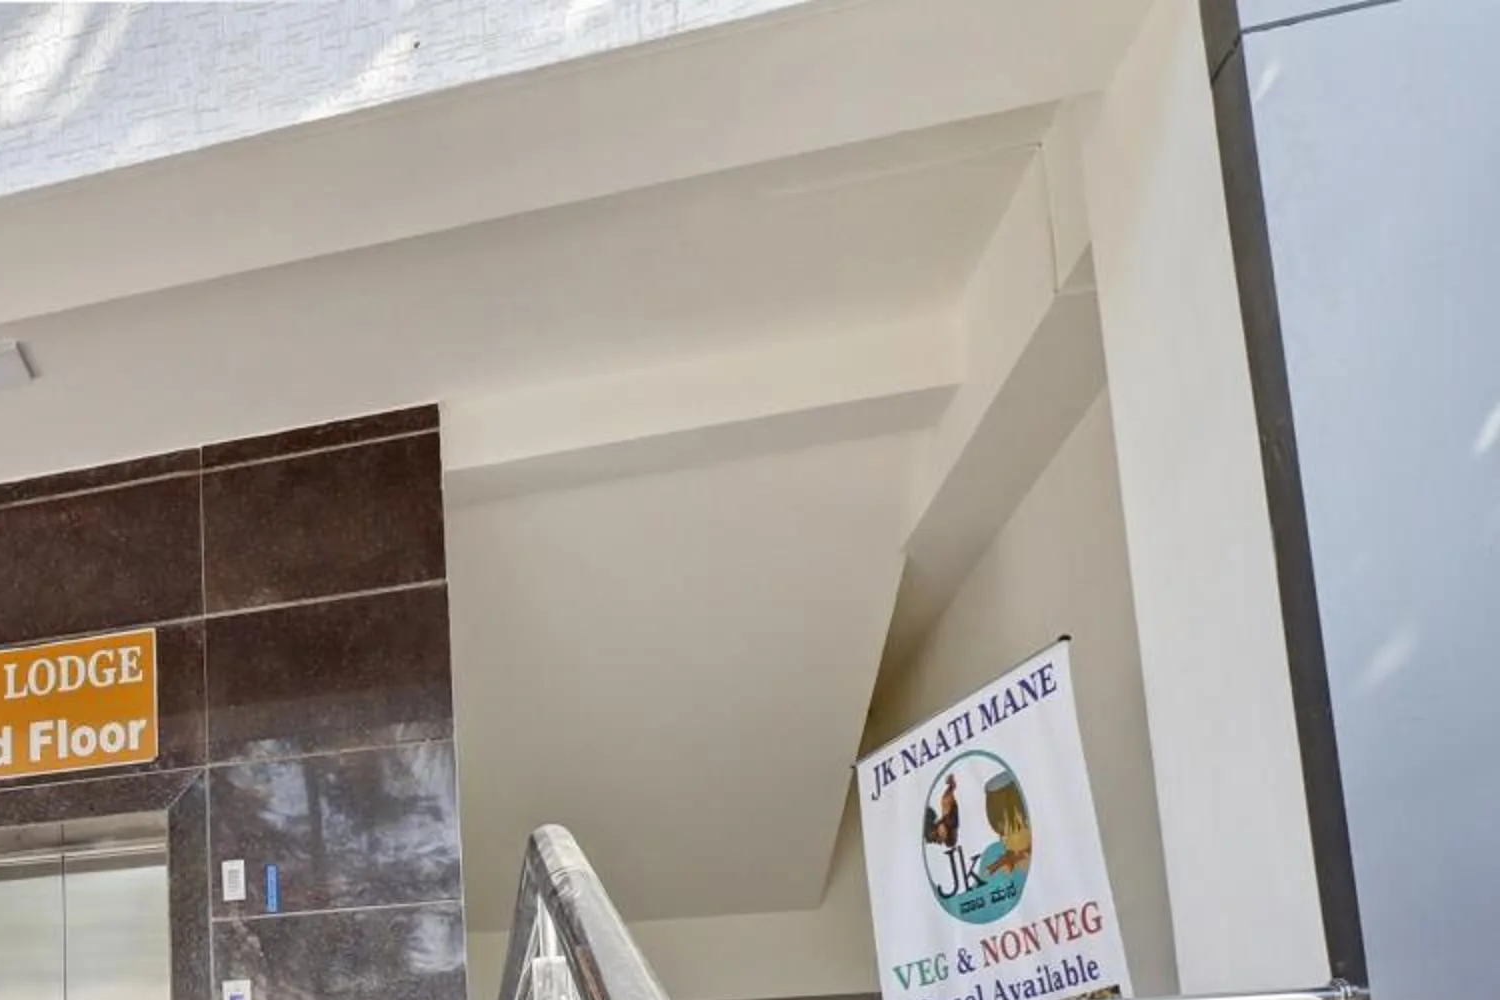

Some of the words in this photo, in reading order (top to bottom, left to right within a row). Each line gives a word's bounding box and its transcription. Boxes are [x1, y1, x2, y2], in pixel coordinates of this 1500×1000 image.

[3, 645, 144, 700] LODGE
[29, 718, 148, 762] Floor
[871, 757, 897, 801] JK
[900, 711, 975, 775] NAATI
[977, 663, 1058, 732] MANE
[893, 953, 949, 991] VEG
[956, 948, 976, 975] &
[979, 922, 1042, 968] NON
[1043, 901, 1104, 946] VEG
